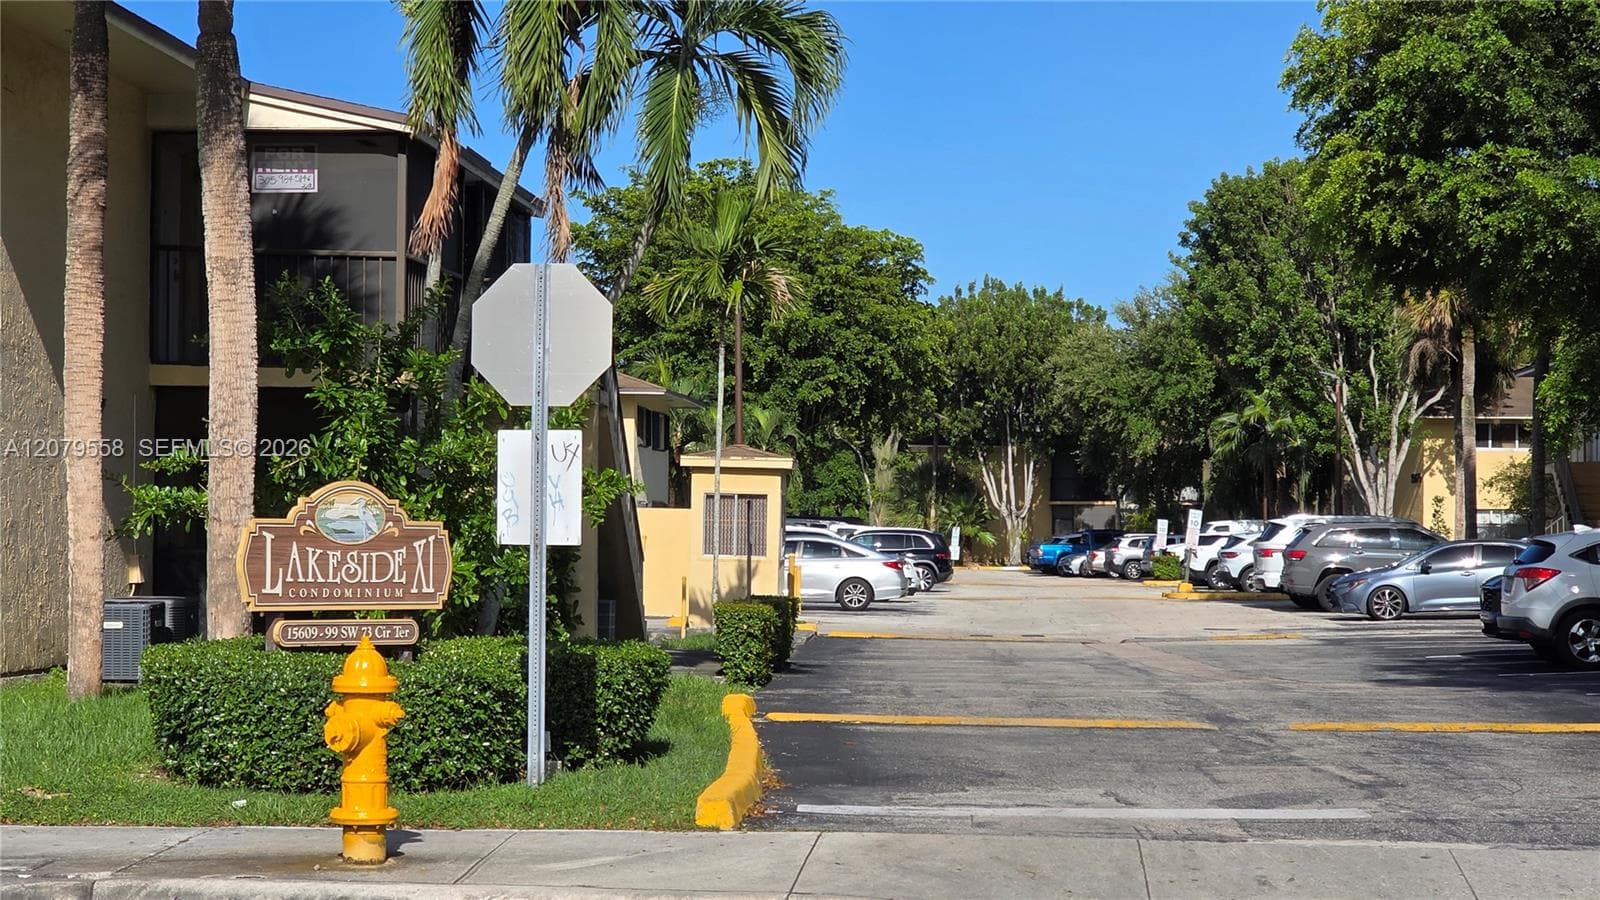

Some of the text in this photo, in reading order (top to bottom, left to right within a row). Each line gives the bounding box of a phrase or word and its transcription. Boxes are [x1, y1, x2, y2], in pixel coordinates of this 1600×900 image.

[261, 531, 436, 597] LAKESIDE XI
[288, 587, 404, 598] CONDOMINIUM
[340, 627, 359, 639] SW
[374, 625, 391, 638] Cir
[393, 625, 410, 638] Ter
